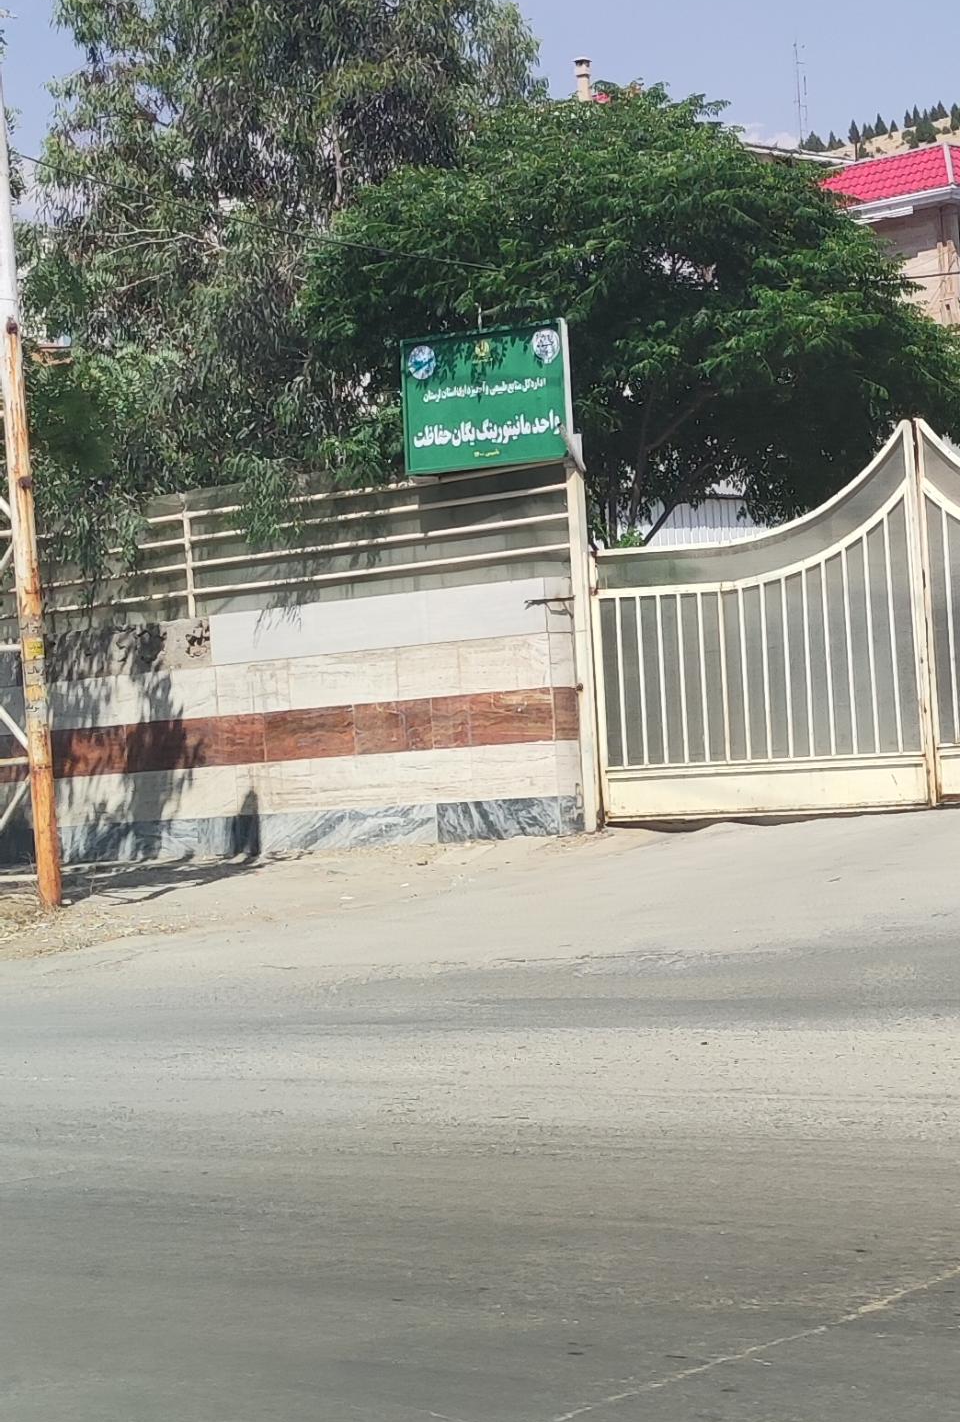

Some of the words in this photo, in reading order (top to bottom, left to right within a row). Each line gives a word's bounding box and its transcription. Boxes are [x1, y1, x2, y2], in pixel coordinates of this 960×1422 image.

[452, 421, 476, 446] یگان
[476, 414, 531, 445] مانیتورینگ
[532, 409, 561, 434] واحد
[414, 424, 452, 448] حفاظت
